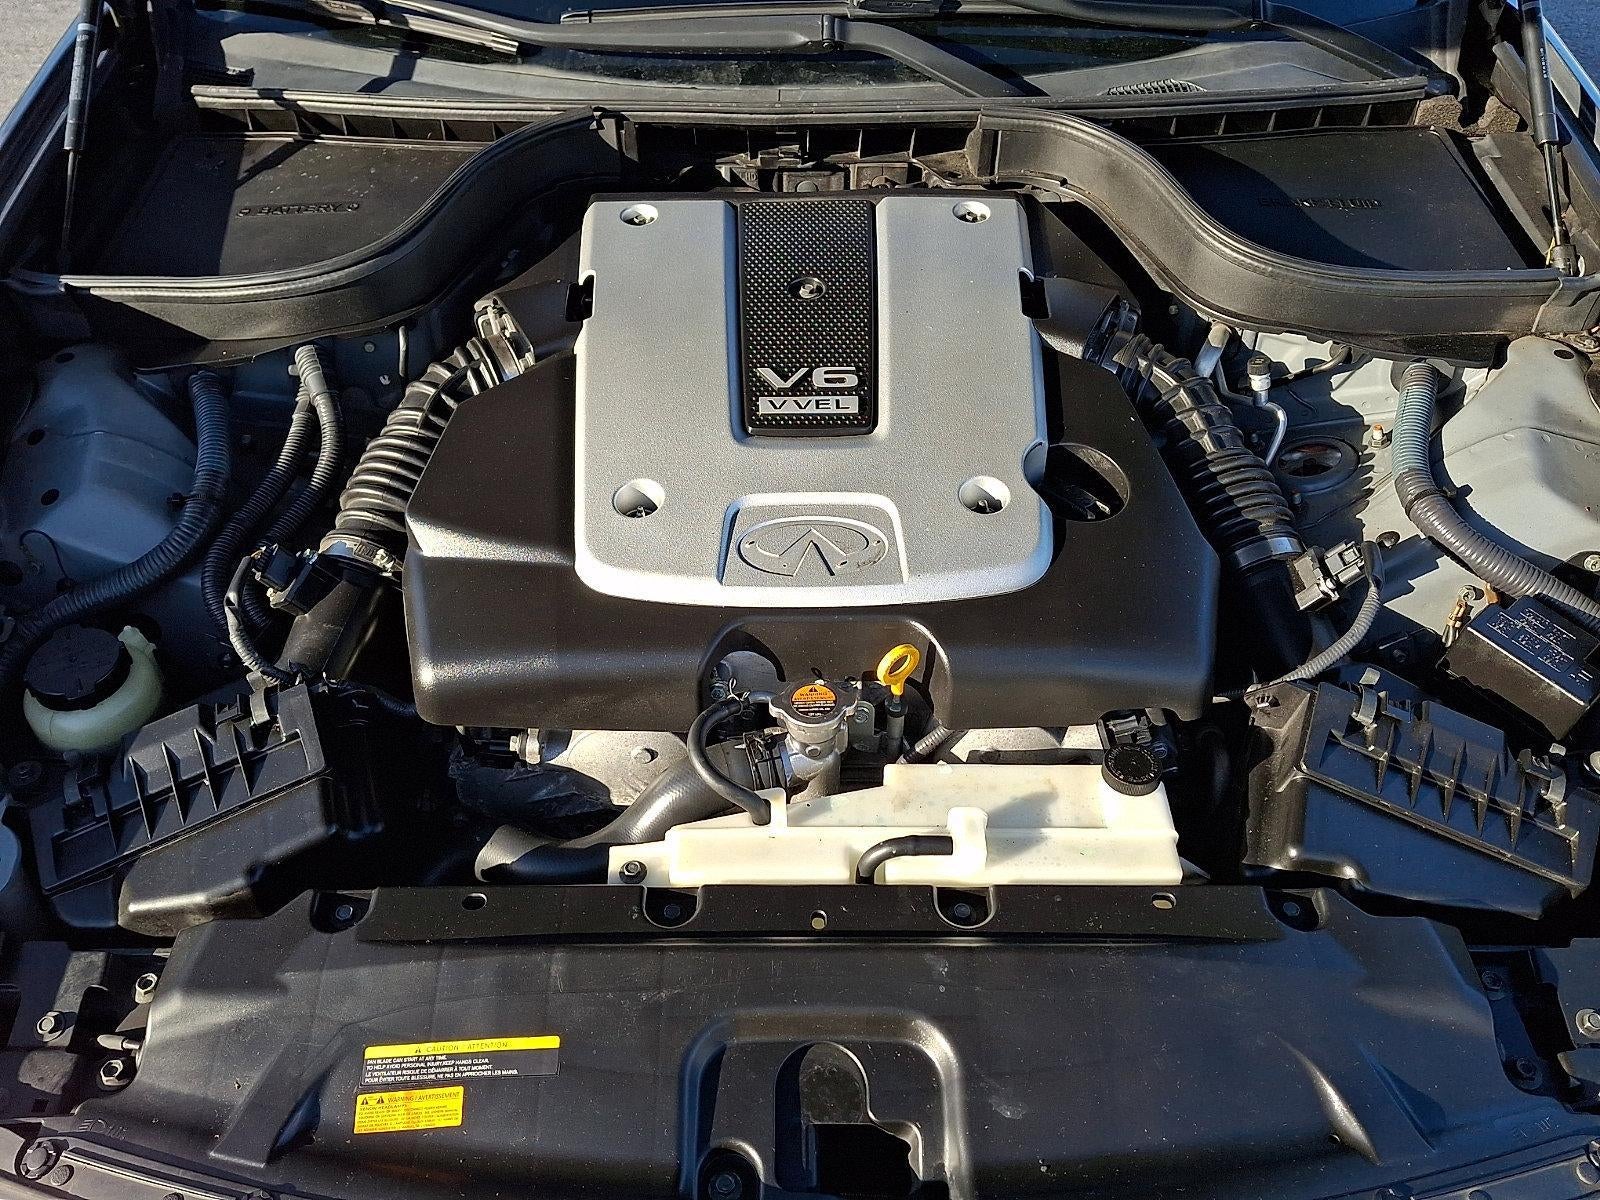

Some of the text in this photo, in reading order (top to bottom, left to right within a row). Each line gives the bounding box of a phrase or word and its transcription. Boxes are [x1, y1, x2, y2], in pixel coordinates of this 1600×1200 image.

[257, 203, 342, 216] BATTERY
[756, 366, 858, 389] V6
[768, 399, 850, 410] VVEL
[418, 1092, 460, 1101] AVERTISSEMENT
